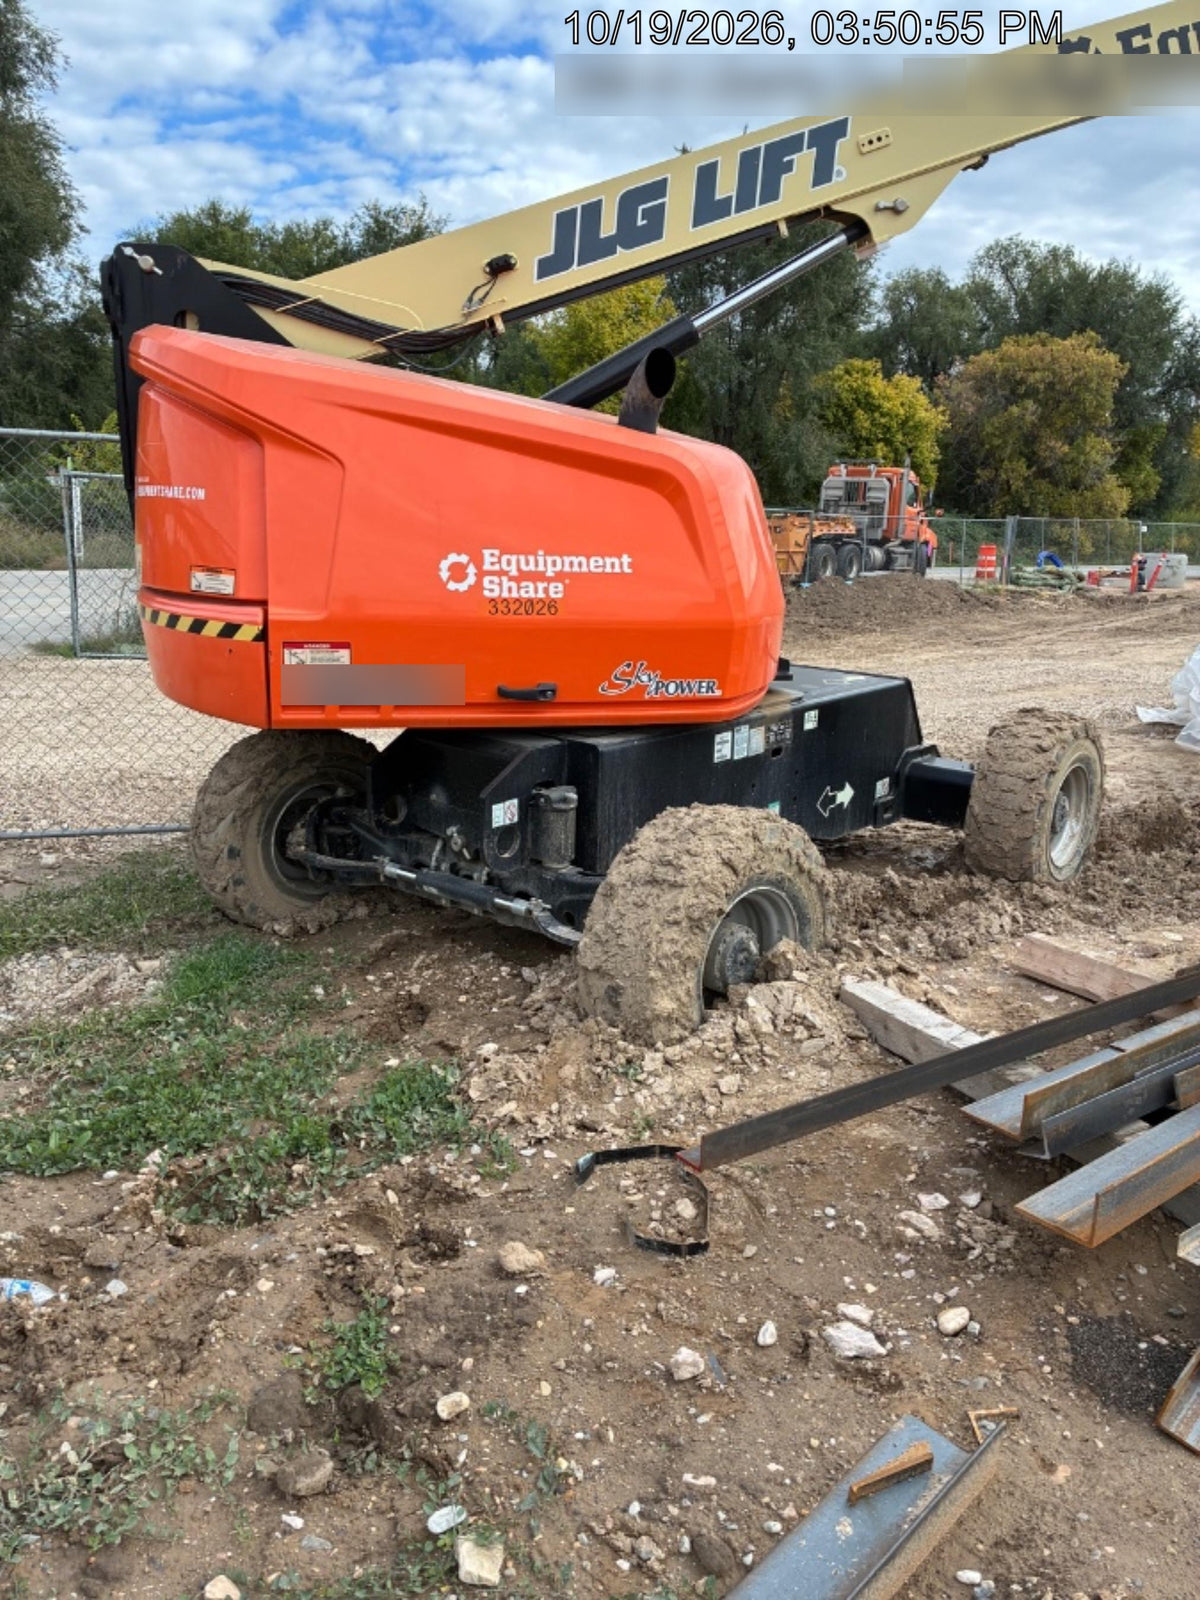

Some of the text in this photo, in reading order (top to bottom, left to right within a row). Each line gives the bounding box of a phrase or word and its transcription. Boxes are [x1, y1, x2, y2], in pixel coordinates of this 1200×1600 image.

[534, 174, 670, 283] JLG
[482, 549, 633, 577] Equipment
[483, 575, 564, 598] Share
[488, 599, 559, 616] 332026
